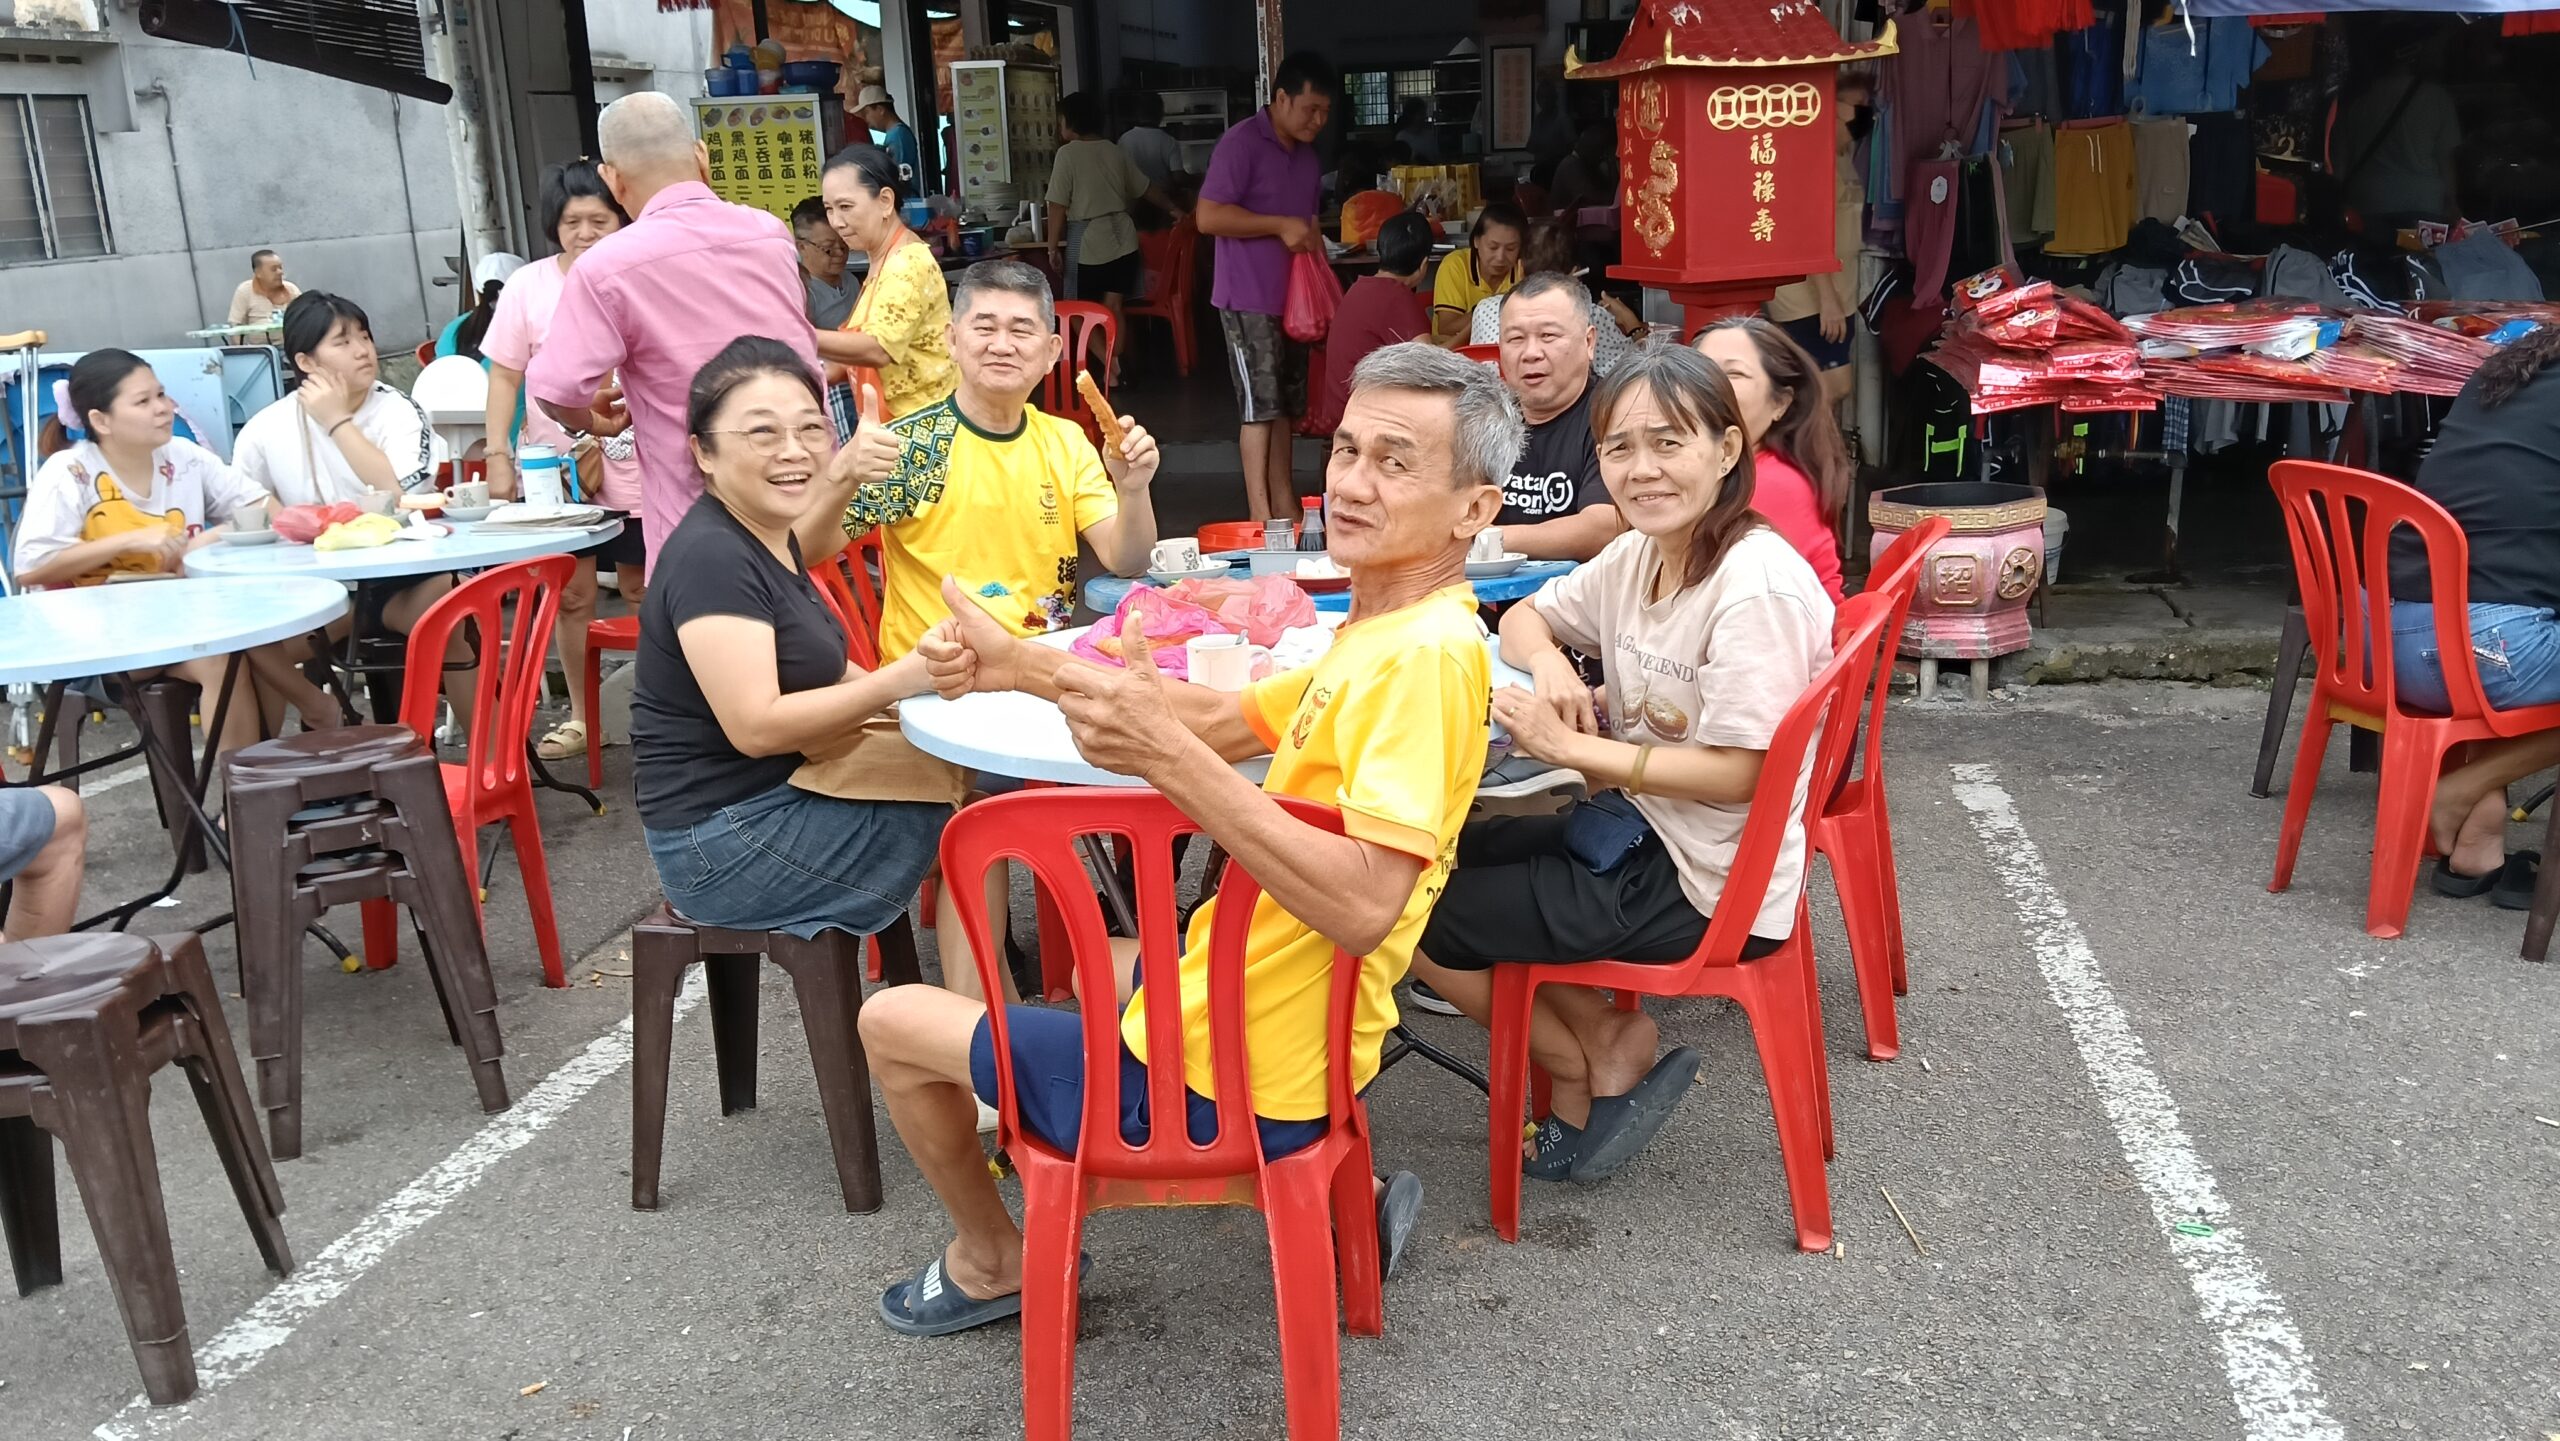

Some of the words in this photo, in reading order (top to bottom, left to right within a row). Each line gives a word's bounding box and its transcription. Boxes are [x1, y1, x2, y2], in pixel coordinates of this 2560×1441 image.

[731, 131, 749, 180] 黑鸡面
[754, 131, 773, 180] 云吞面
[777, 130, 796, 179] 咖喱面
[799, 129, 817, 179] 猪肉粉
